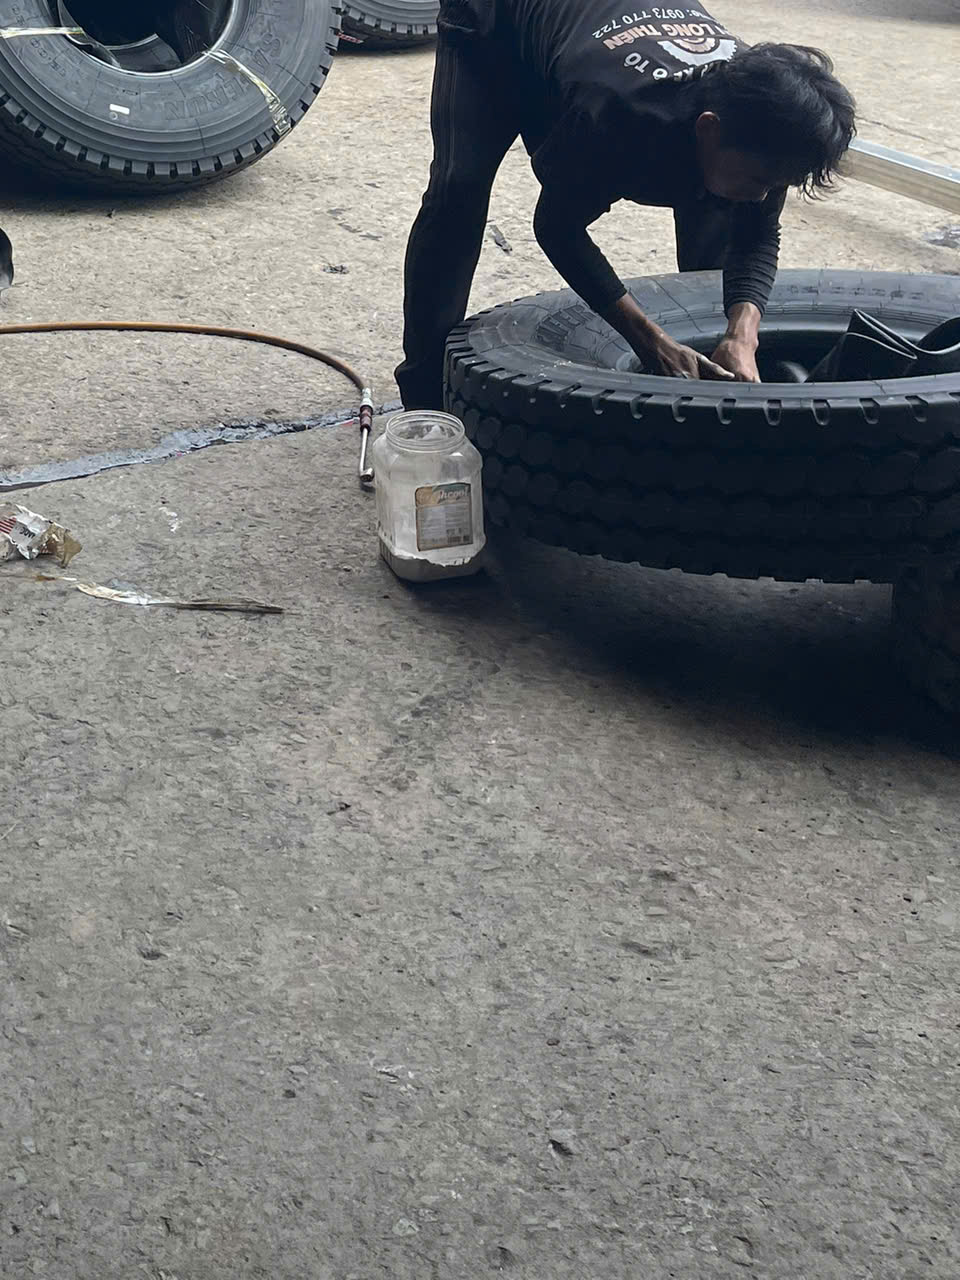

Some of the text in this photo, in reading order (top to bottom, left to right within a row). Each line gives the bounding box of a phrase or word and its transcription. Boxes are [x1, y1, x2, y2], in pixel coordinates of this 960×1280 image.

[622, 9, 651, 25] 770
[652, 7, 684, 20] 0973
[592, 22, 621, 39] 722
[667, 23, 717, 37] LONG
[623, 52, 649, 73] TÔ
